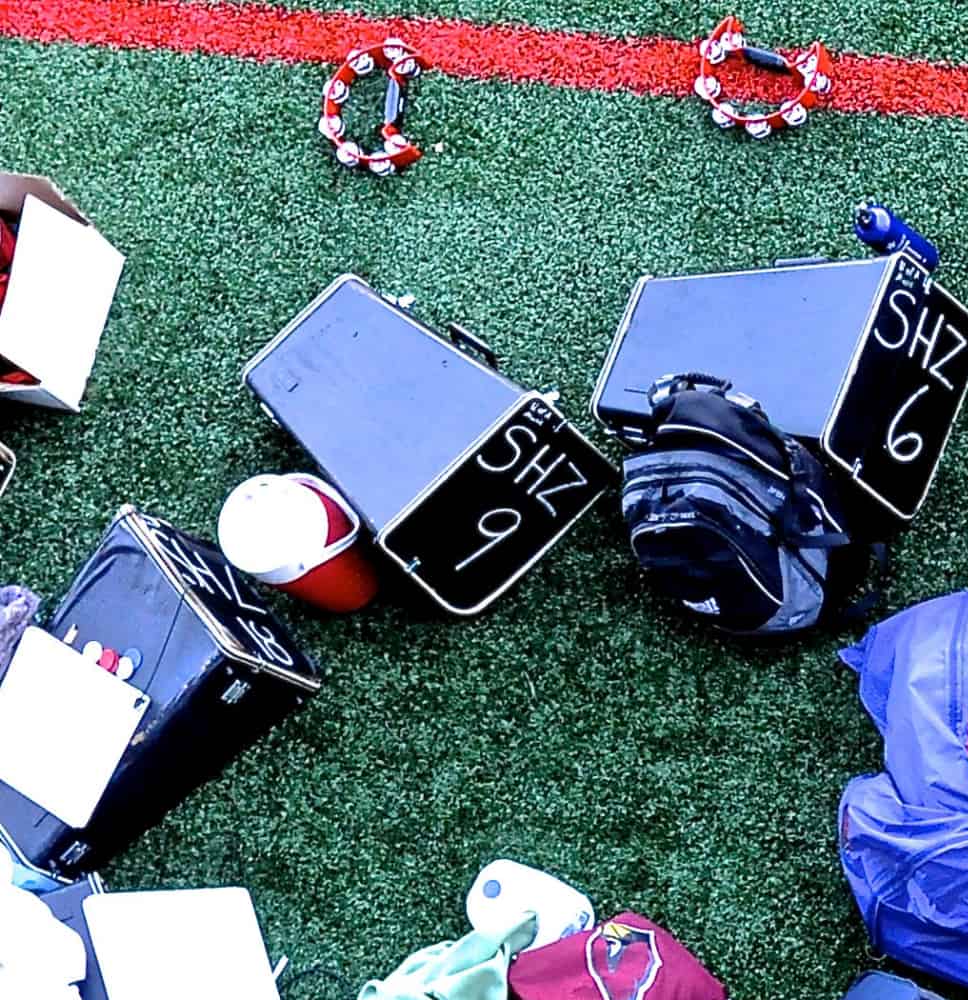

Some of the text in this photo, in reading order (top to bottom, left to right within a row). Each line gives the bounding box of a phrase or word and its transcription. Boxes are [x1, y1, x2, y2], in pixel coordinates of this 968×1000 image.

[875, 288, 967, 390] SHZ
[887, 384, 923, 462] 6
[477, 425, 588, 517] SHZ
[455, 508, 522, 572] 9
[236, 616, 293, 668] 18
